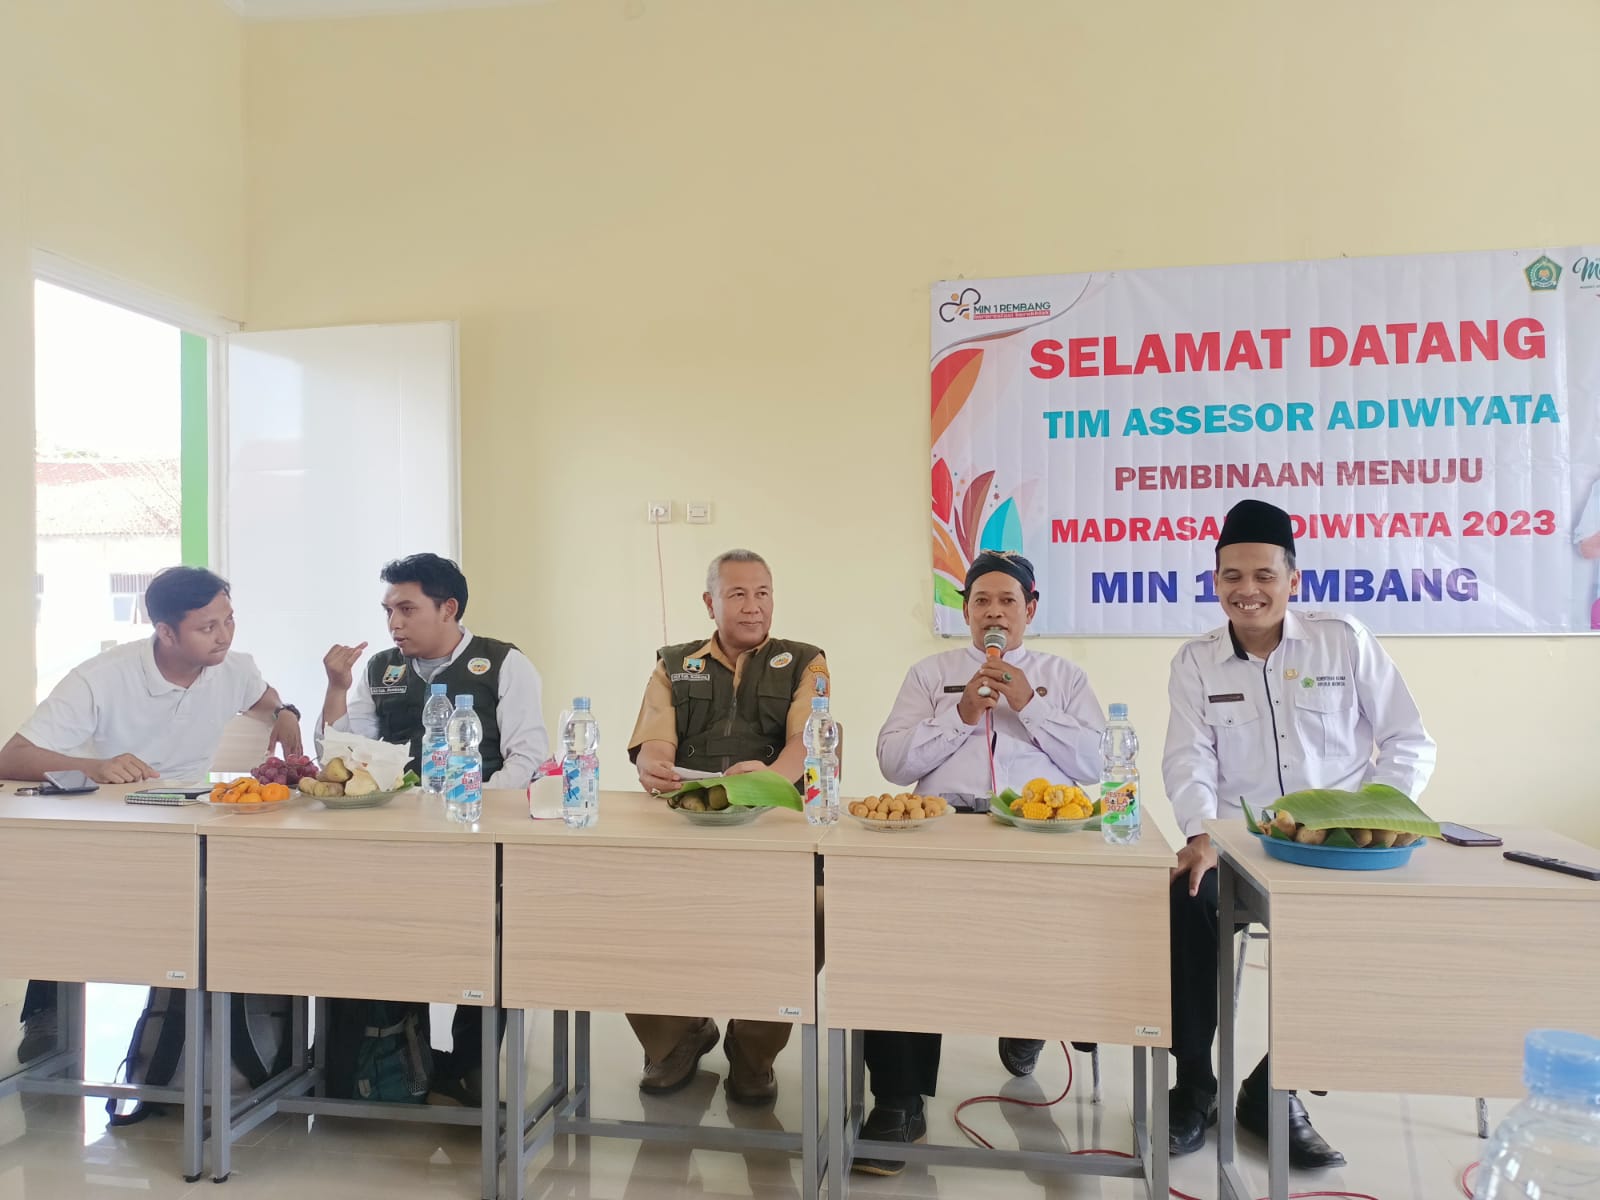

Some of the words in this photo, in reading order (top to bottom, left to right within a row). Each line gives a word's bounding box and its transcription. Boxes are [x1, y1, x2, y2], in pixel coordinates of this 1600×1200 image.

[974, 305, 992, 314] MIN
[993, 304, 998, 313] 1
[1000, 302, 1051, 312] REMBANG
[1029, 328, 1291, 379] SELAMAT
[1309, 317, 1546, 367] DATANG
[1043, 409, 1110, 439] TIM
[1122, 402, 1314, 437] ASSESOR
[1327, 393, 1561, 431] ADIWIYATA
[1115, 461, 1324, 491] PEMBINAAN
[1337, 457, 1483, 486] MENUJU
[1051, 515, 1227, 543] MADRASA
[1289, 511, 1452, 540] DIWIYATA
[1462, 509, 1556, 537] 2023
[1091, 570, 1178, 604] MIN
[1194, 569, 1220, 603] 1
[1288, 567, 1479, 603] MBANG
